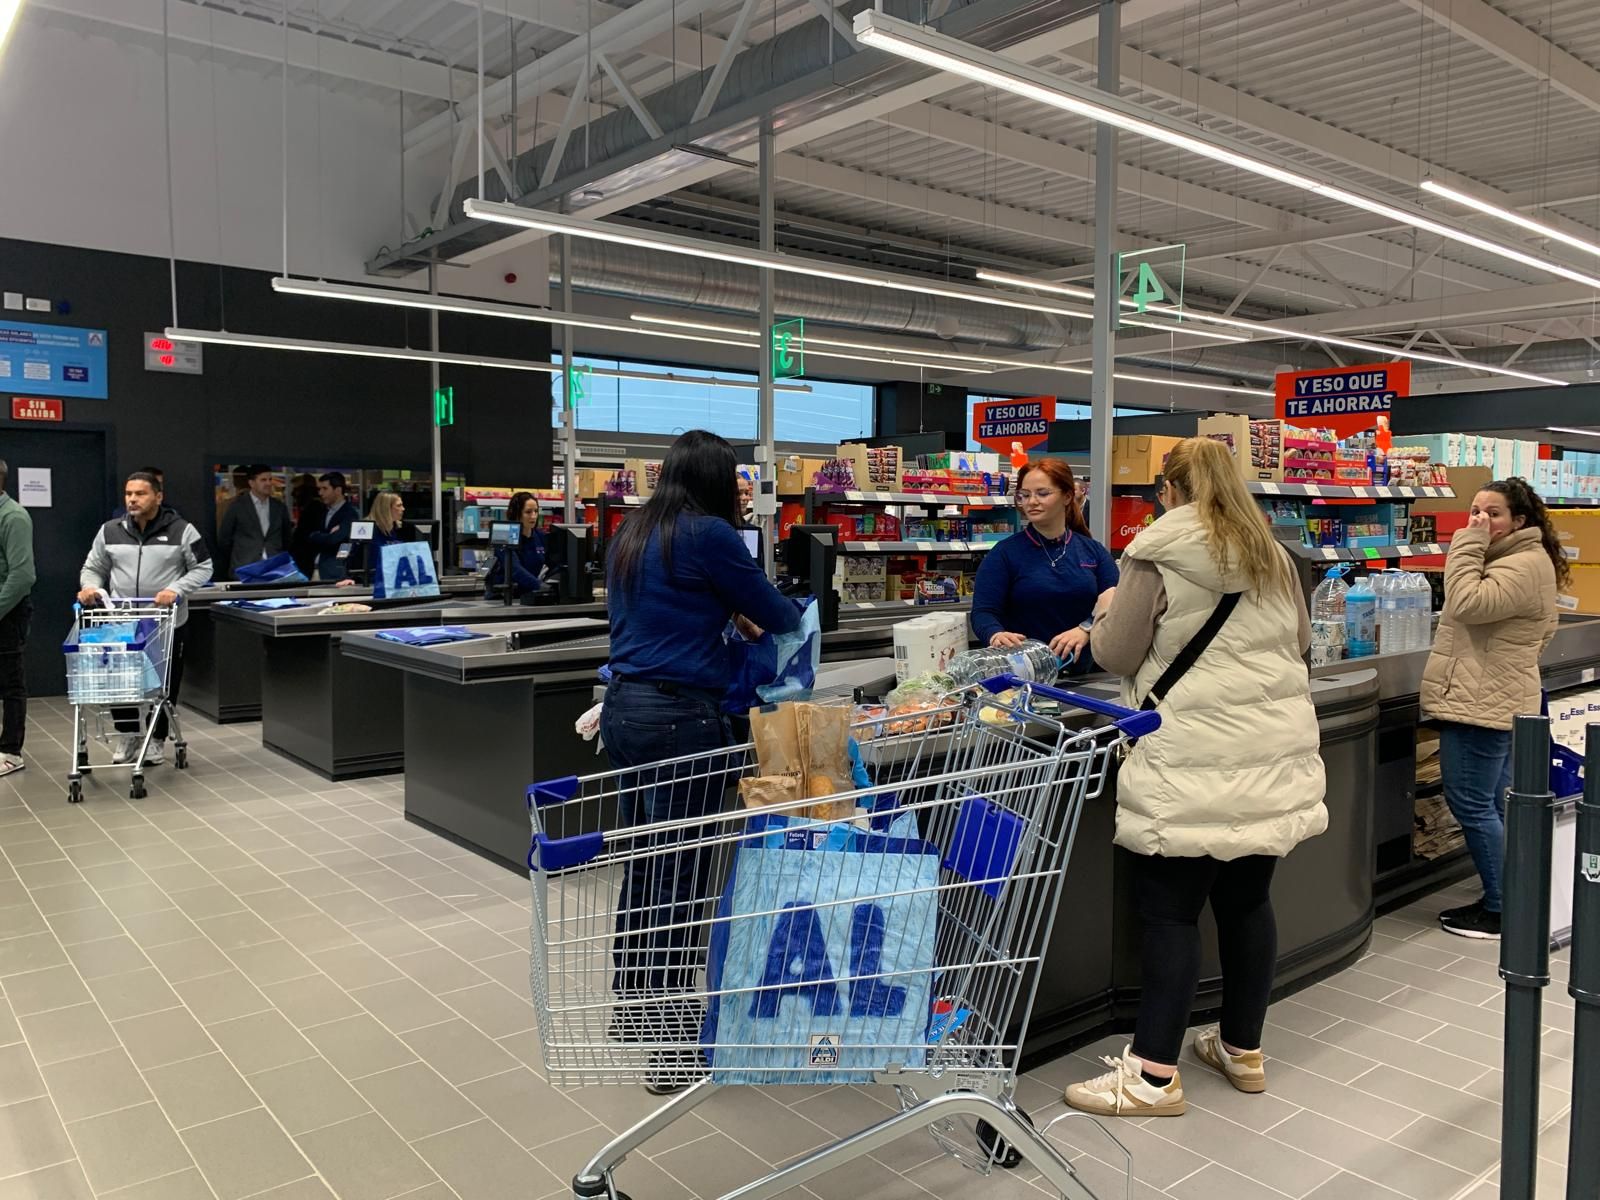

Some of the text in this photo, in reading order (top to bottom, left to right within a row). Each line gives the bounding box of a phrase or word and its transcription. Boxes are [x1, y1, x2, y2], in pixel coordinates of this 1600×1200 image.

[1298, 373, 1384, 394] Y ESO QUE
[19, 408, 56, 418] SALIDA
[29, 400, 46, 409] SIN
[986, 404, 1040, 420] Y ESO QUE
[1287, 394, 1393, 415] TE AHORRAS
[980, 421, 1046, 436] TE AHORRAS
[394, 554, 433, 589] AL
[748, 900, 907, 1019] AL
